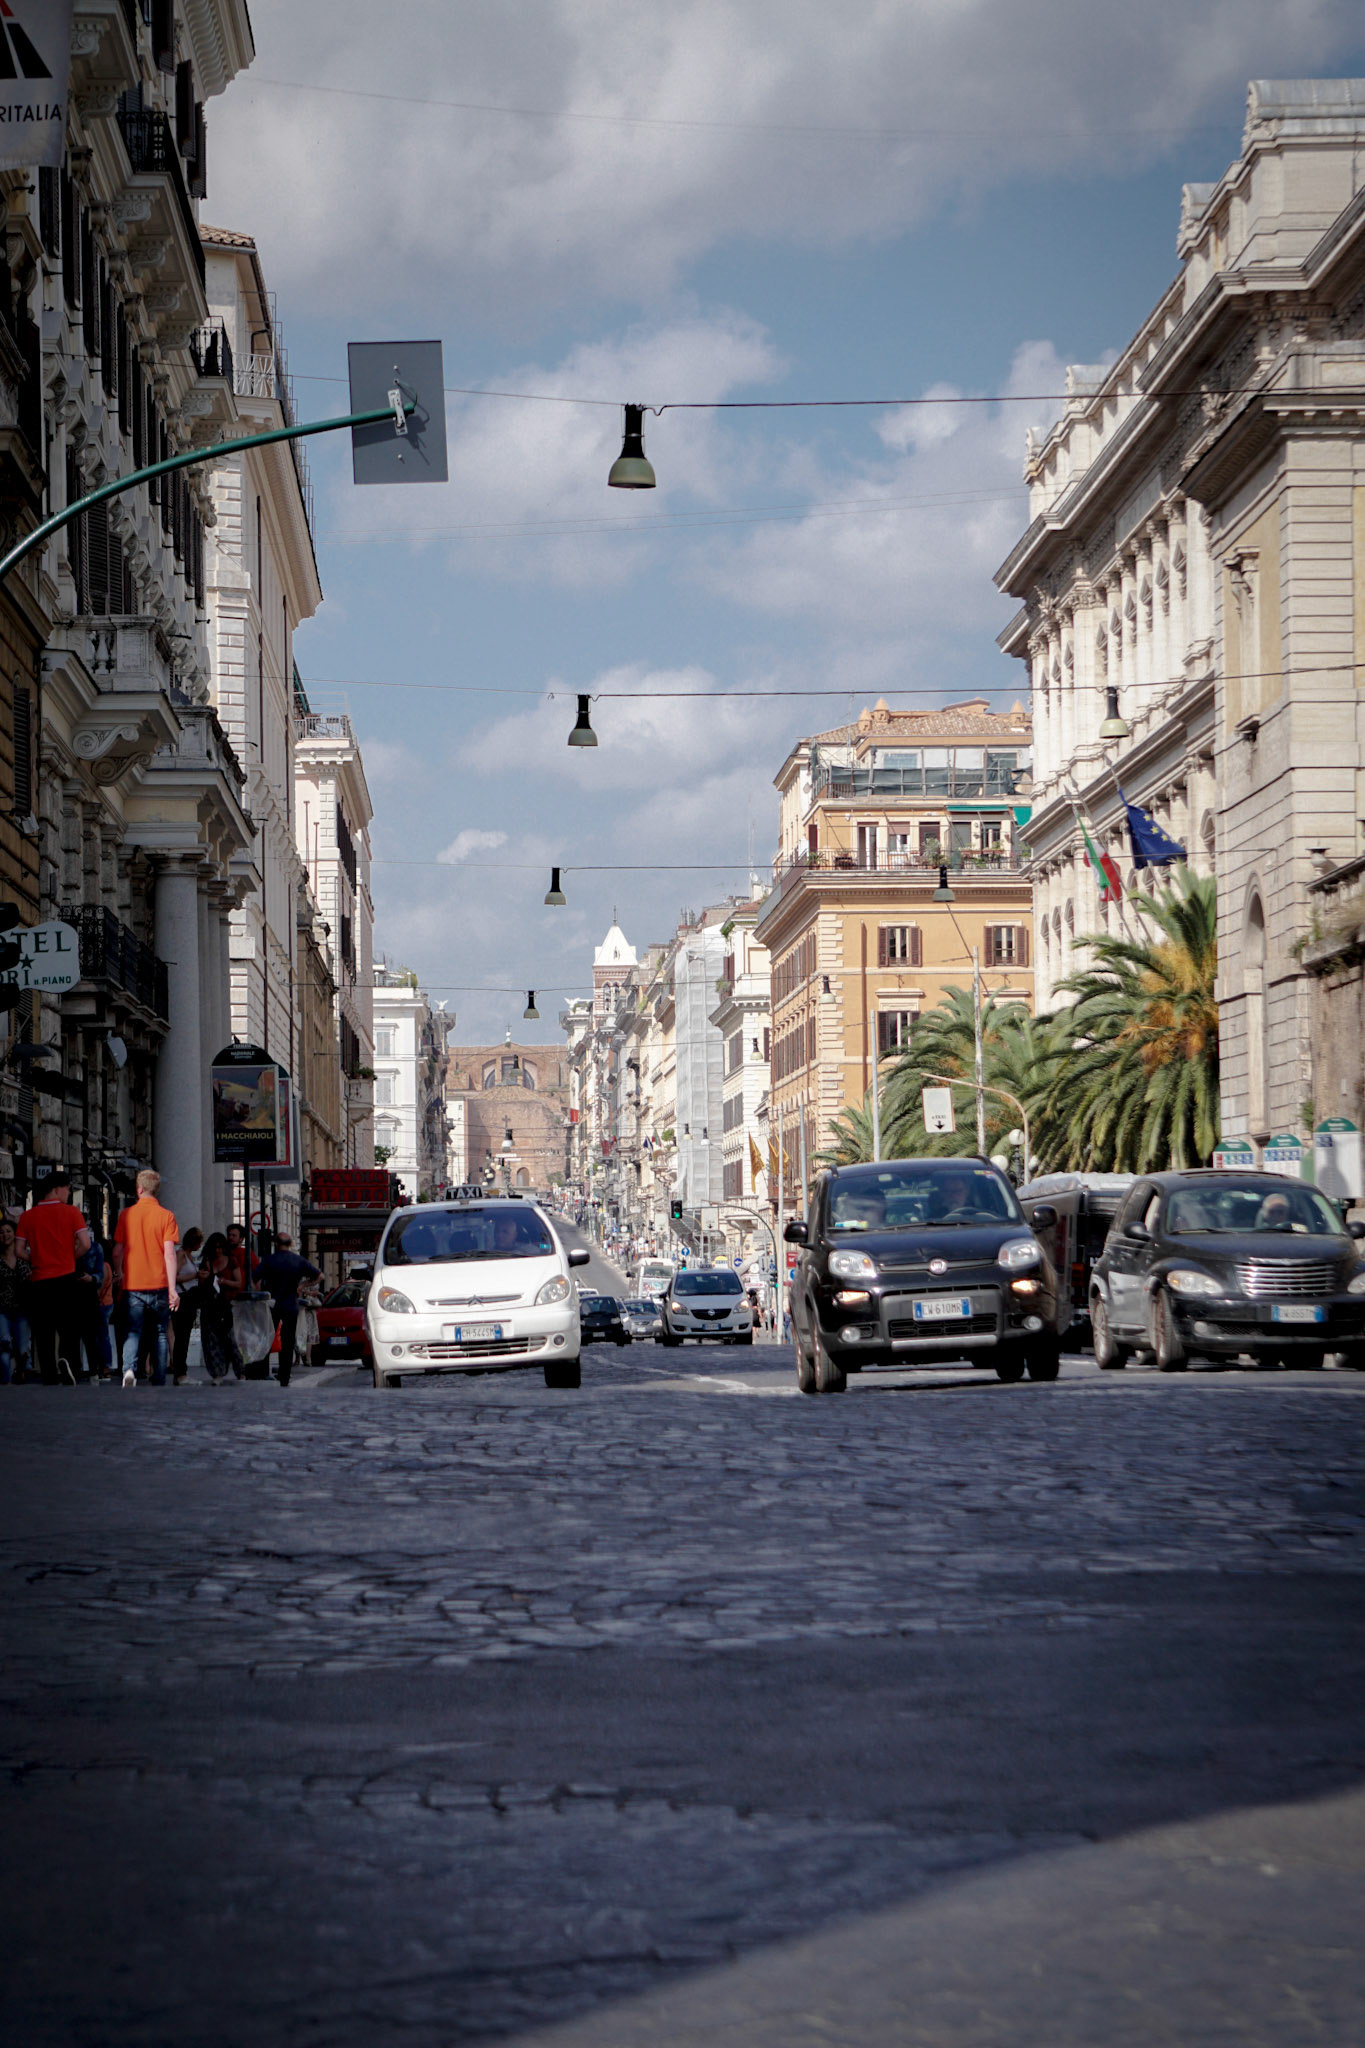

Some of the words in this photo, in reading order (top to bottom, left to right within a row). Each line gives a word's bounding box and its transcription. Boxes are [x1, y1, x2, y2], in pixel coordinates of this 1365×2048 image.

[0, 931, 71, 953] TEL
[42, 976, 72, 985] PIANO
[313, 1171, 387, 1183] PICCOLO
[448, 1187, 480, 1199] TAXI
